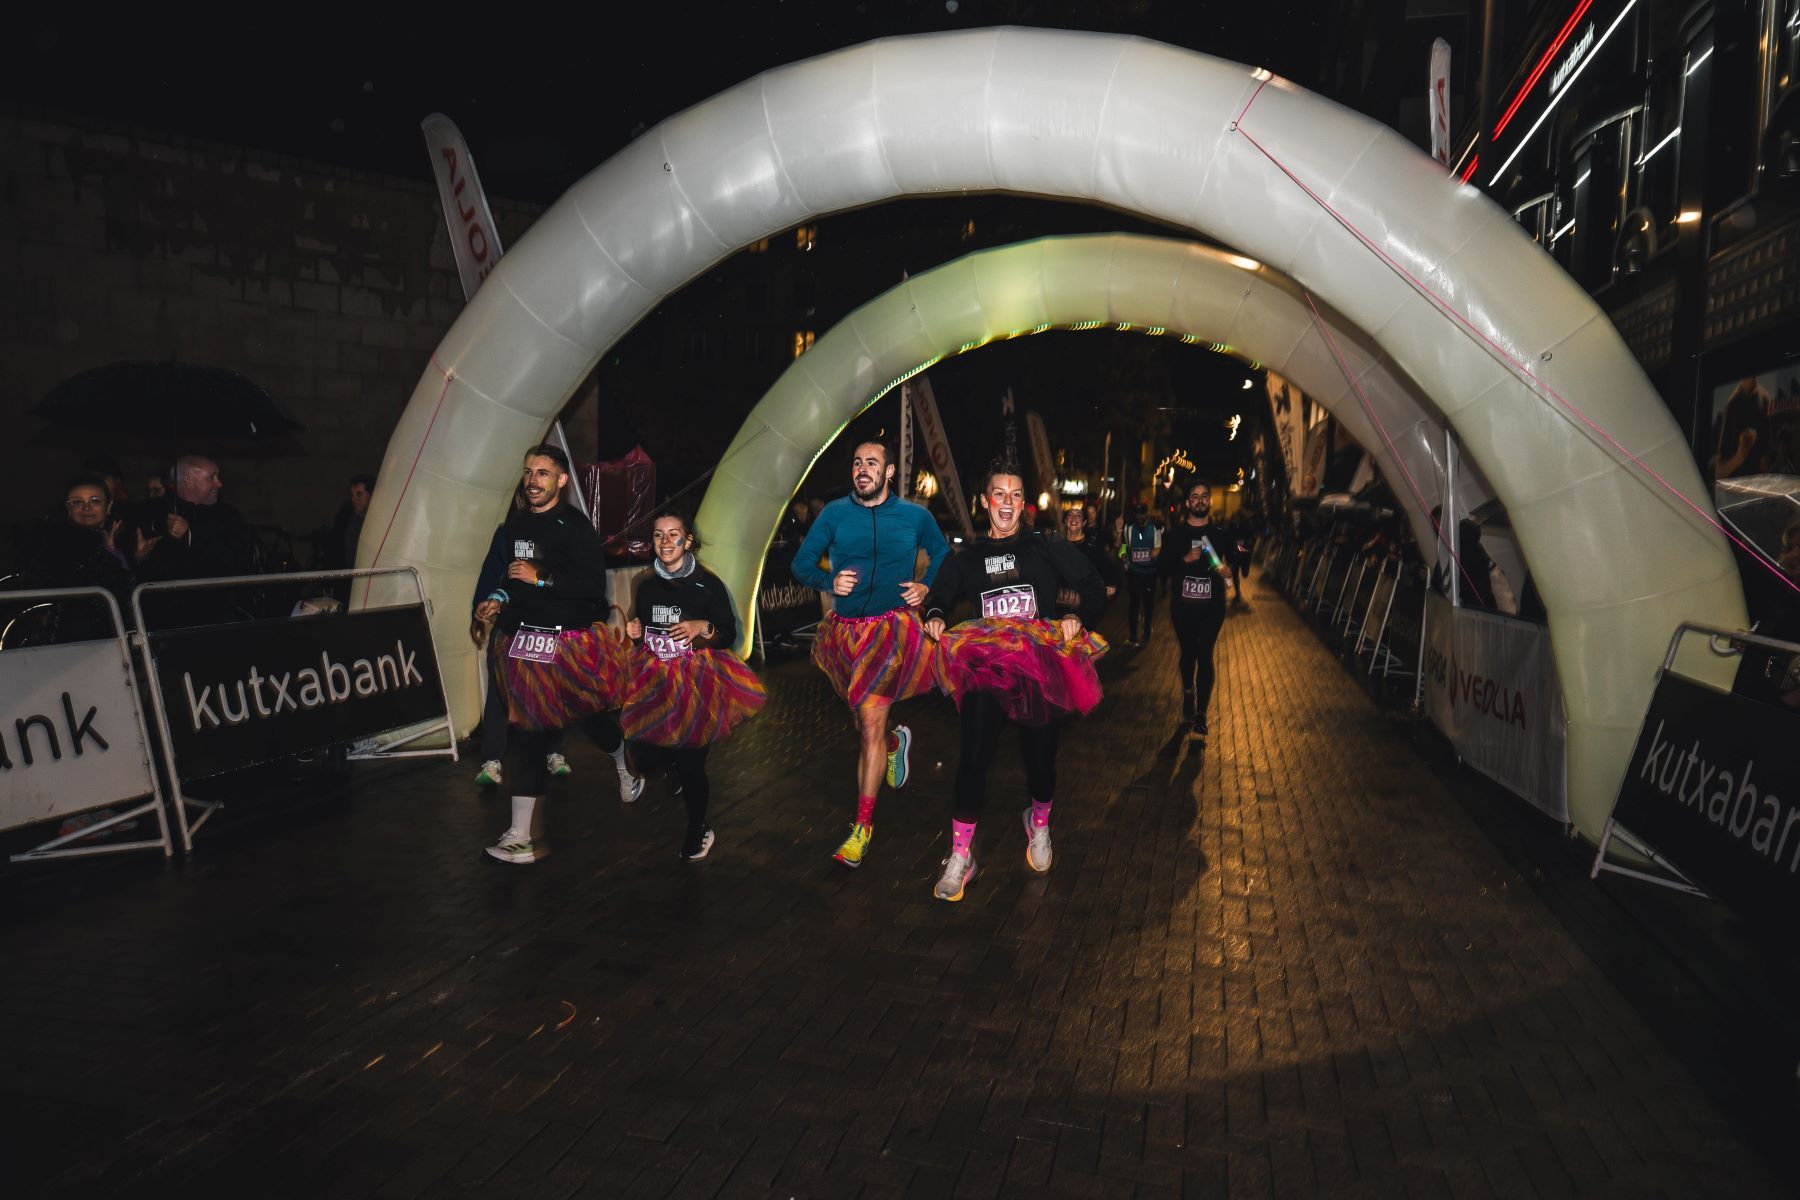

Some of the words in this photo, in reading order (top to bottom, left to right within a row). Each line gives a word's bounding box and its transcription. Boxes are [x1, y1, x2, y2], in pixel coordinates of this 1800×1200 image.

[1185, 581, 1211, 594] 1200
[985, 595, 1032, 617] 1027
[517, 634, 557, 654] 1098
[183, 639, 424, 731] kutxabank
[1460, 667, 1526, 731] VEOLIA
